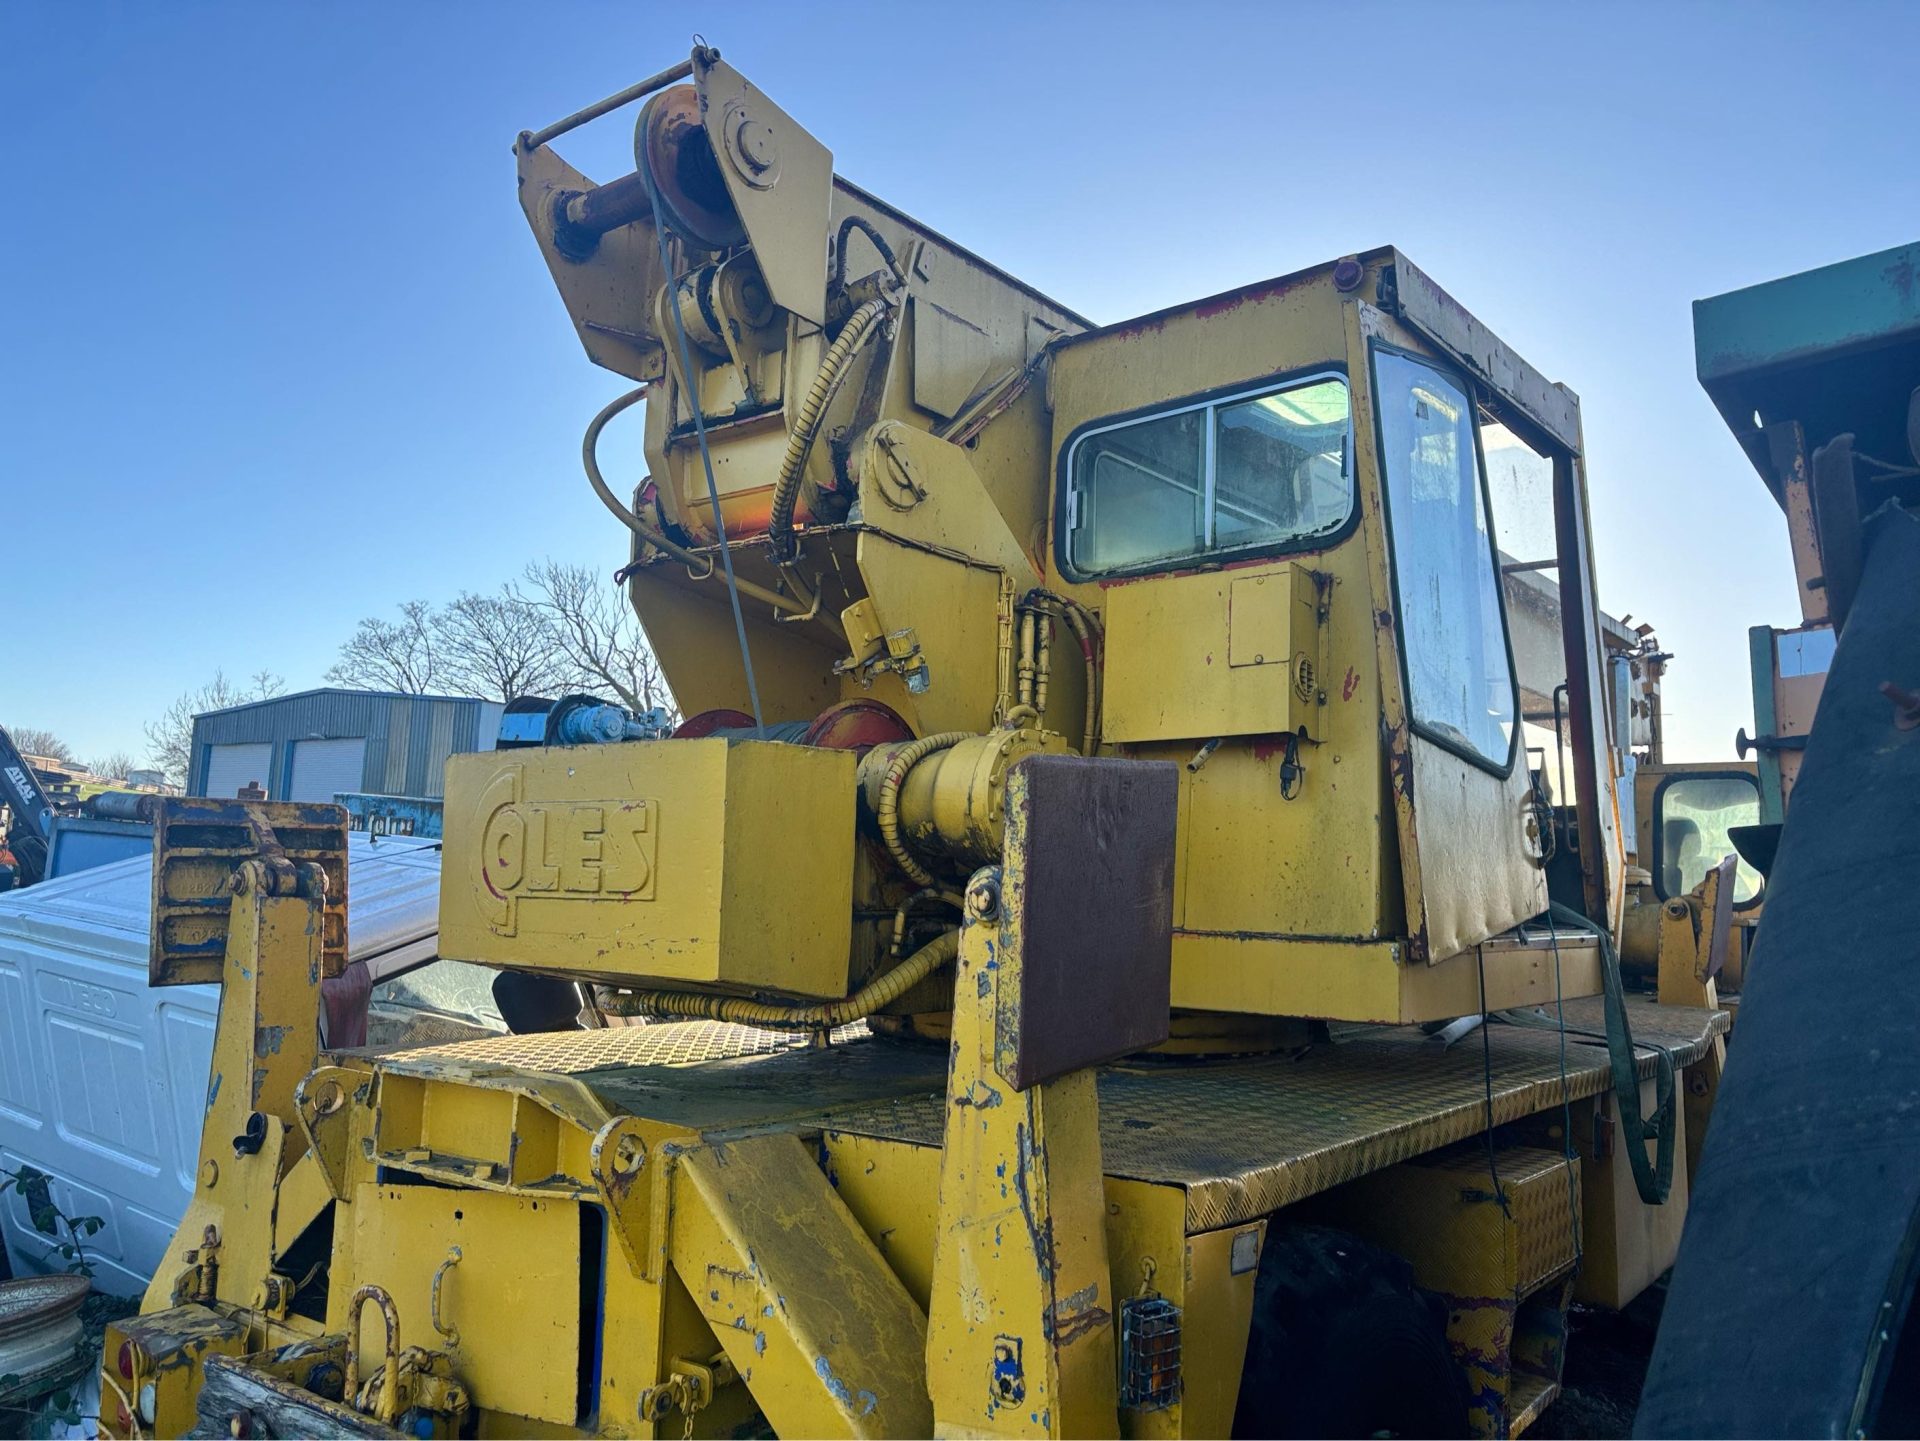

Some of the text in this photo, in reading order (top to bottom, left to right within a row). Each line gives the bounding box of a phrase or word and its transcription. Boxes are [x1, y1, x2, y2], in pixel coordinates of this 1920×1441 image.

[8, 766, 36, 800] ATLAS
[470, 764, 655, 936] COLES
[58, 977, 118, 1019] IVECO
